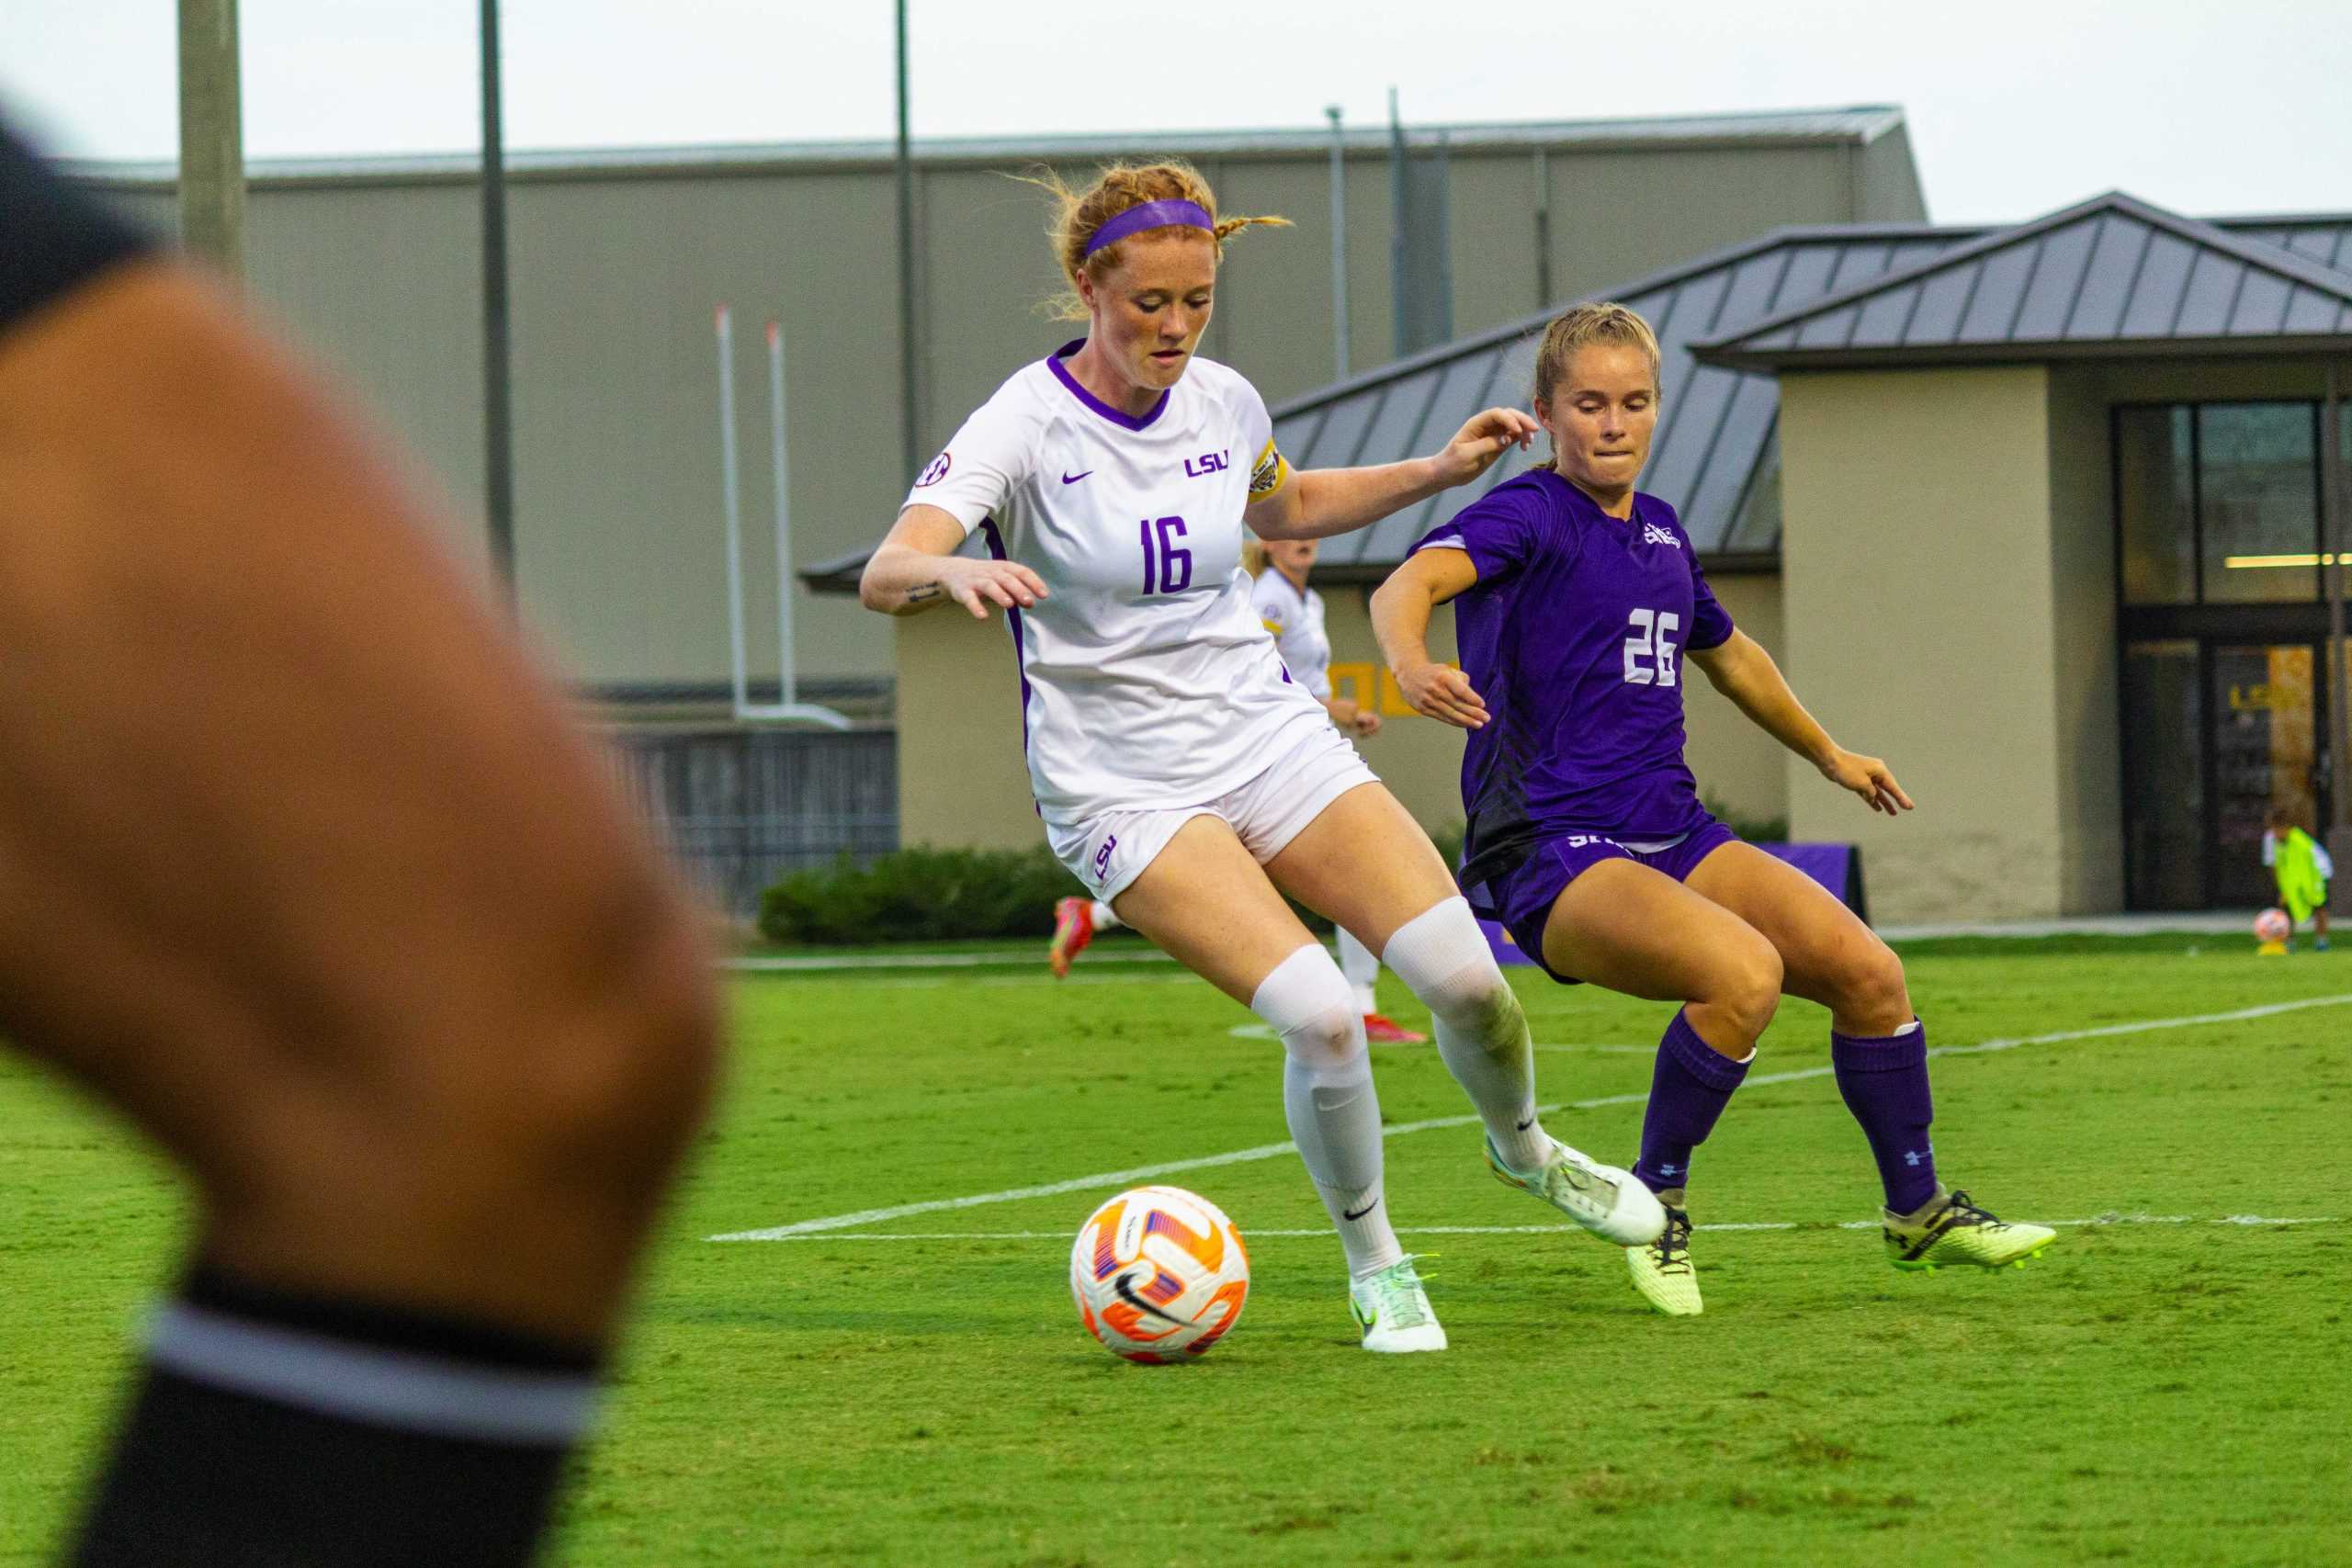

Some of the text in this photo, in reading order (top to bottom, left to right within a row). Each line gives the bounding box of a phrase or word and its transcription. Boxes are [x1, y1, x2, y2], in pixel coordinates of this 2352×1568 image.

[1183, 449, 1229, 479] LSU
[1140, 515, 1193, 595] 16
[1623, 608, 1679, 687] 26
[1094, 833, 1118, 881] LSU
